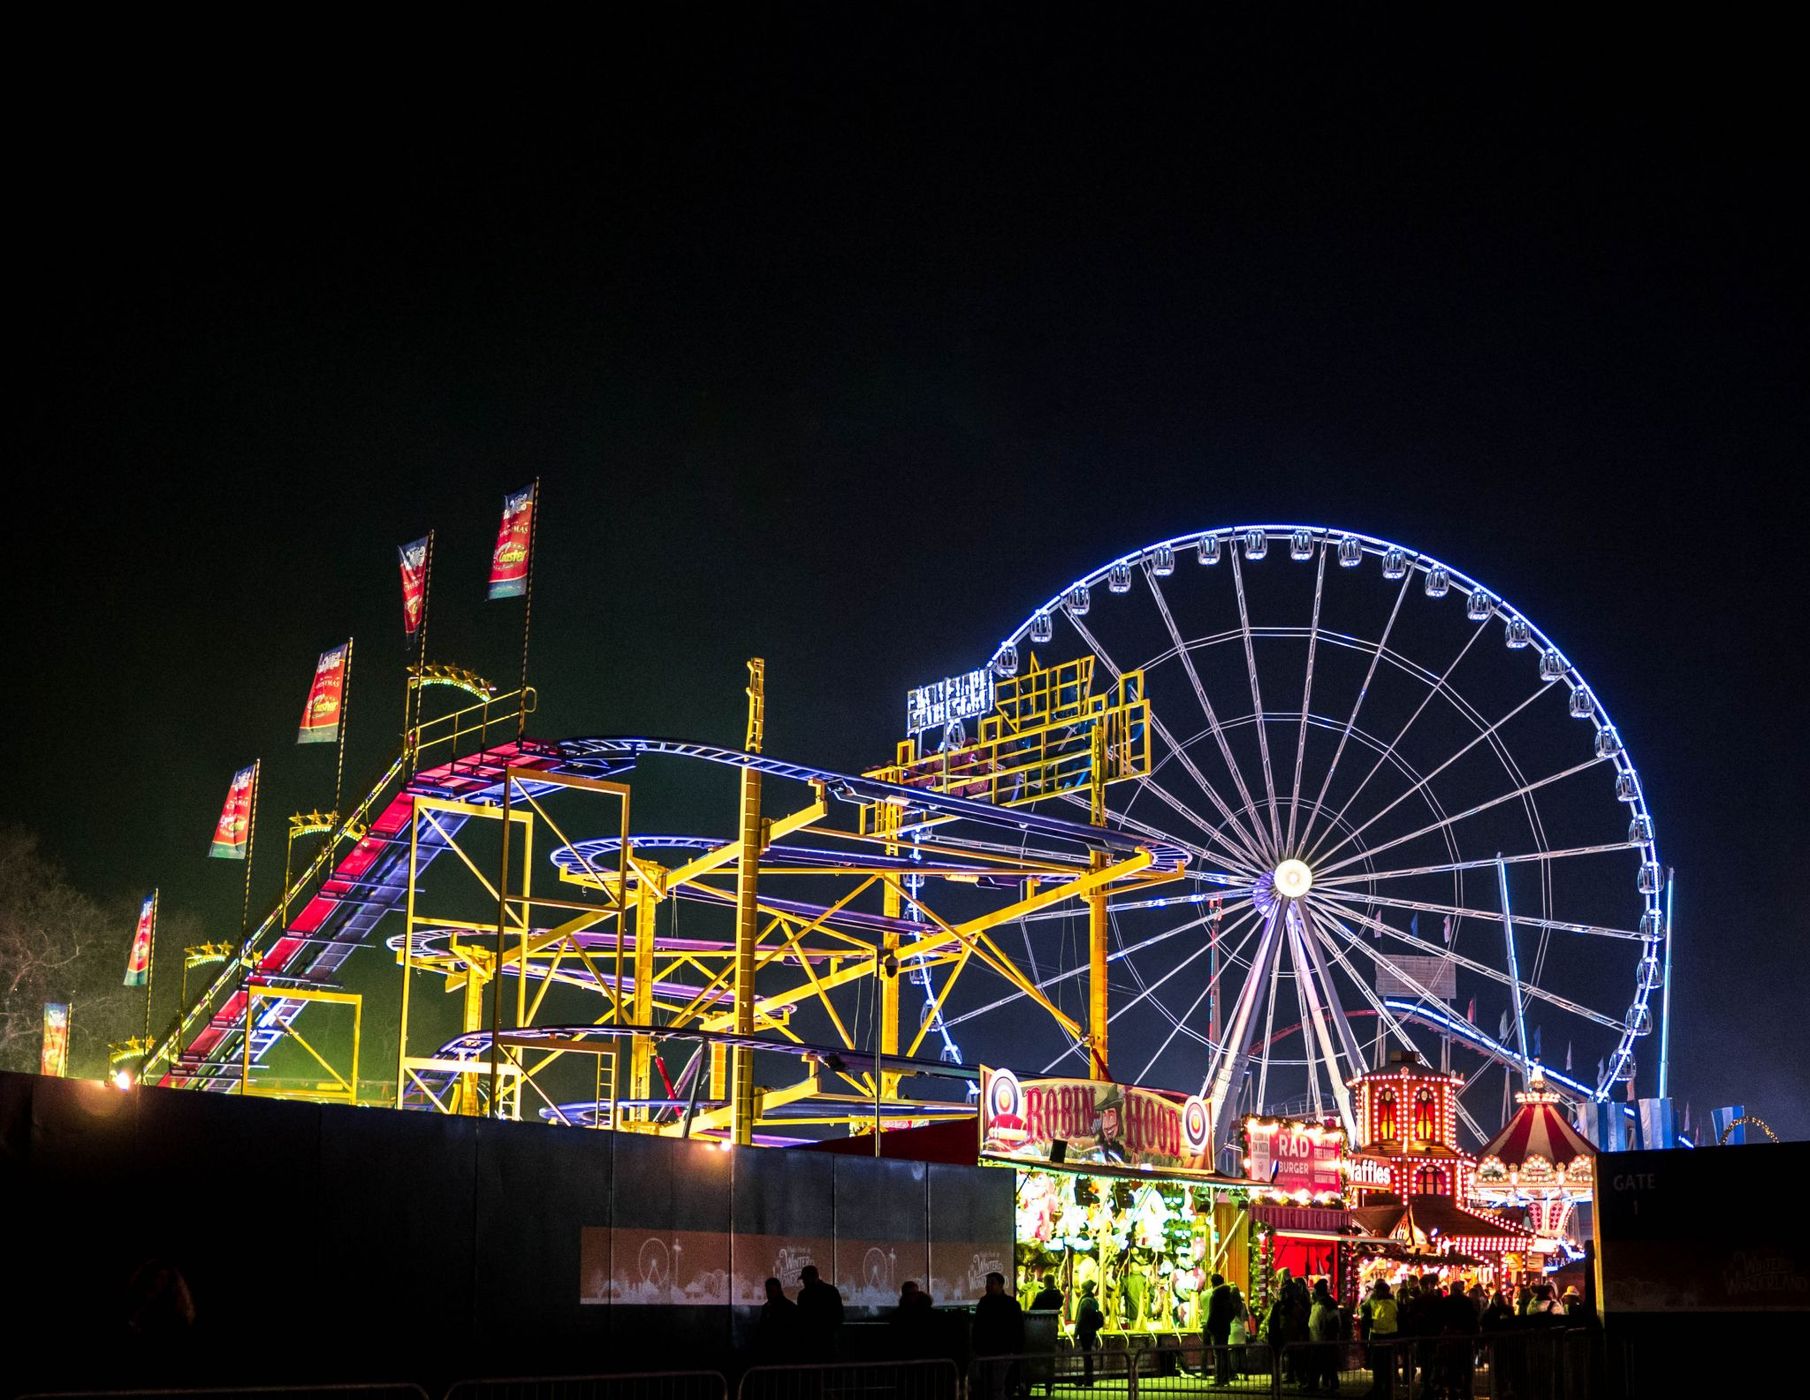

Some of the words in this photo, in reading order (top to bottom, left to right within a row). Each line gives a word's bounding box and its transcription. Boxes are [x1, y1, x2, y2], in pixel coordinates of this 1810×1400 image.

[1024, 1085, 1096, 1139] ROBIN
[1123, 1086, 1181, 1158] HOOD
[1278, 1134, 1309, 1158] RAD
[1278, 1161, 1309, 1175] BURGER
[1613, 1174, 1656, 1192] GATE
